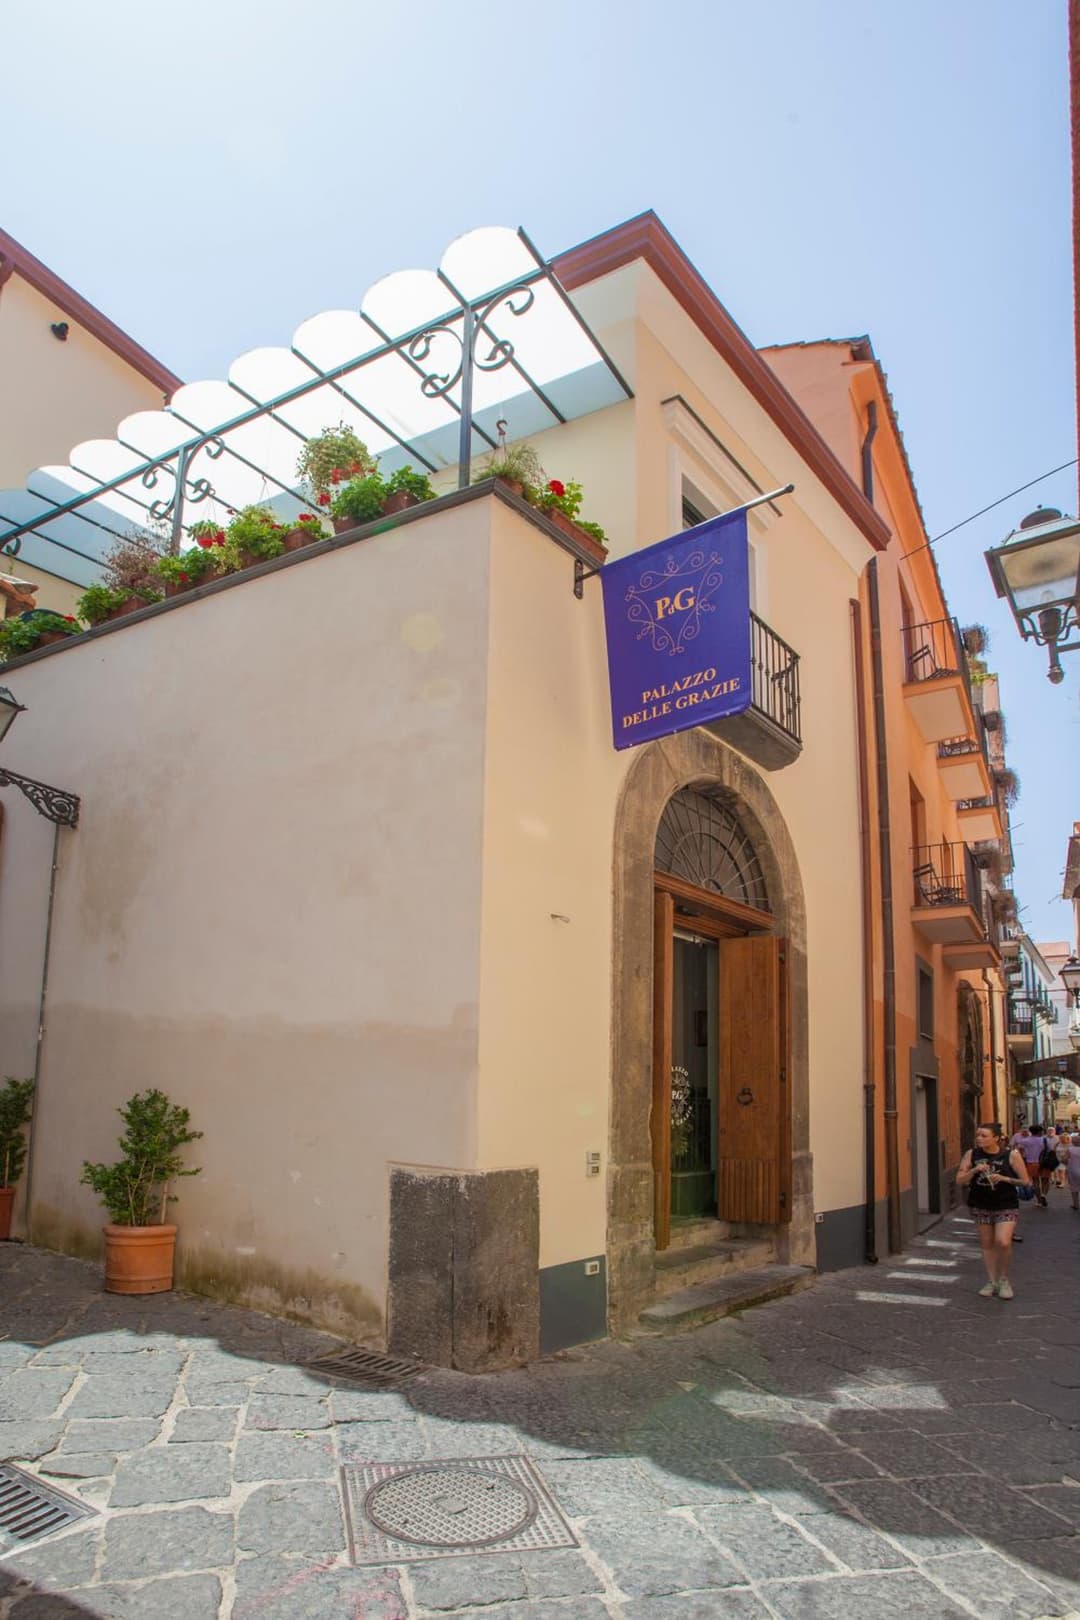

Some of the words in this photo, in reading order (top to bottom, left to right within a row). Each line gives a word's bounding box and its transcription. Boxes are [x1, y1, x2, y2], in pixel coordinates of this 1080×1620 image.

[622, 701, 672, 728] DELLE
[675, 678, 741, 709] GRAZIE
[642, 667, 717, 704] PALAZZO
